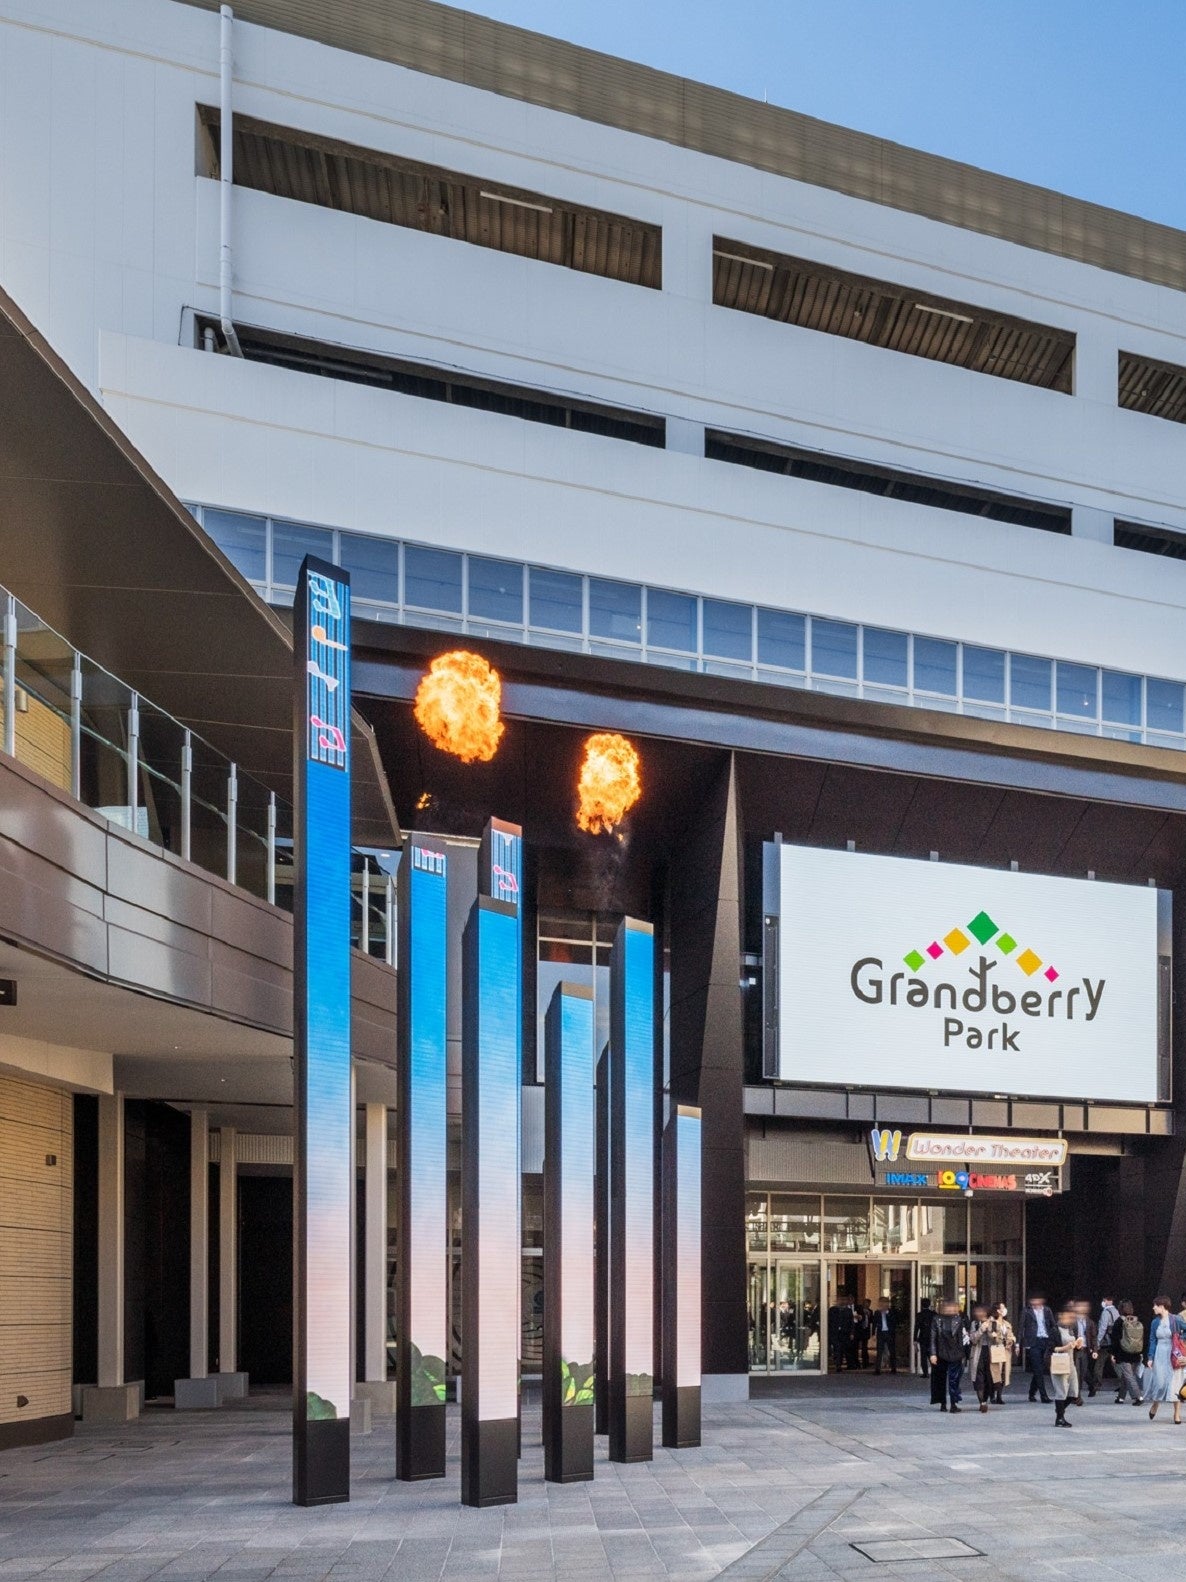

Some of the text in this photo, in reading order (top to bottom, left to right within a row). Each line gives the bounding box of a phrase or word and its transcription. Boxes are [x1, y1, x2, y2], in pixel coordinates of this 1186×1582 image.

[850, 955, 1106, 1022] Grandberry
[943, 1017, 1021, 1052] Park
[913, 1140, 986, 1157] Wonder
[990, 1144, 1060, 1160] Theater
[885, 1172, 929, 1186] IMAX
[1025, 1171, 1052, 1185] 4DX
